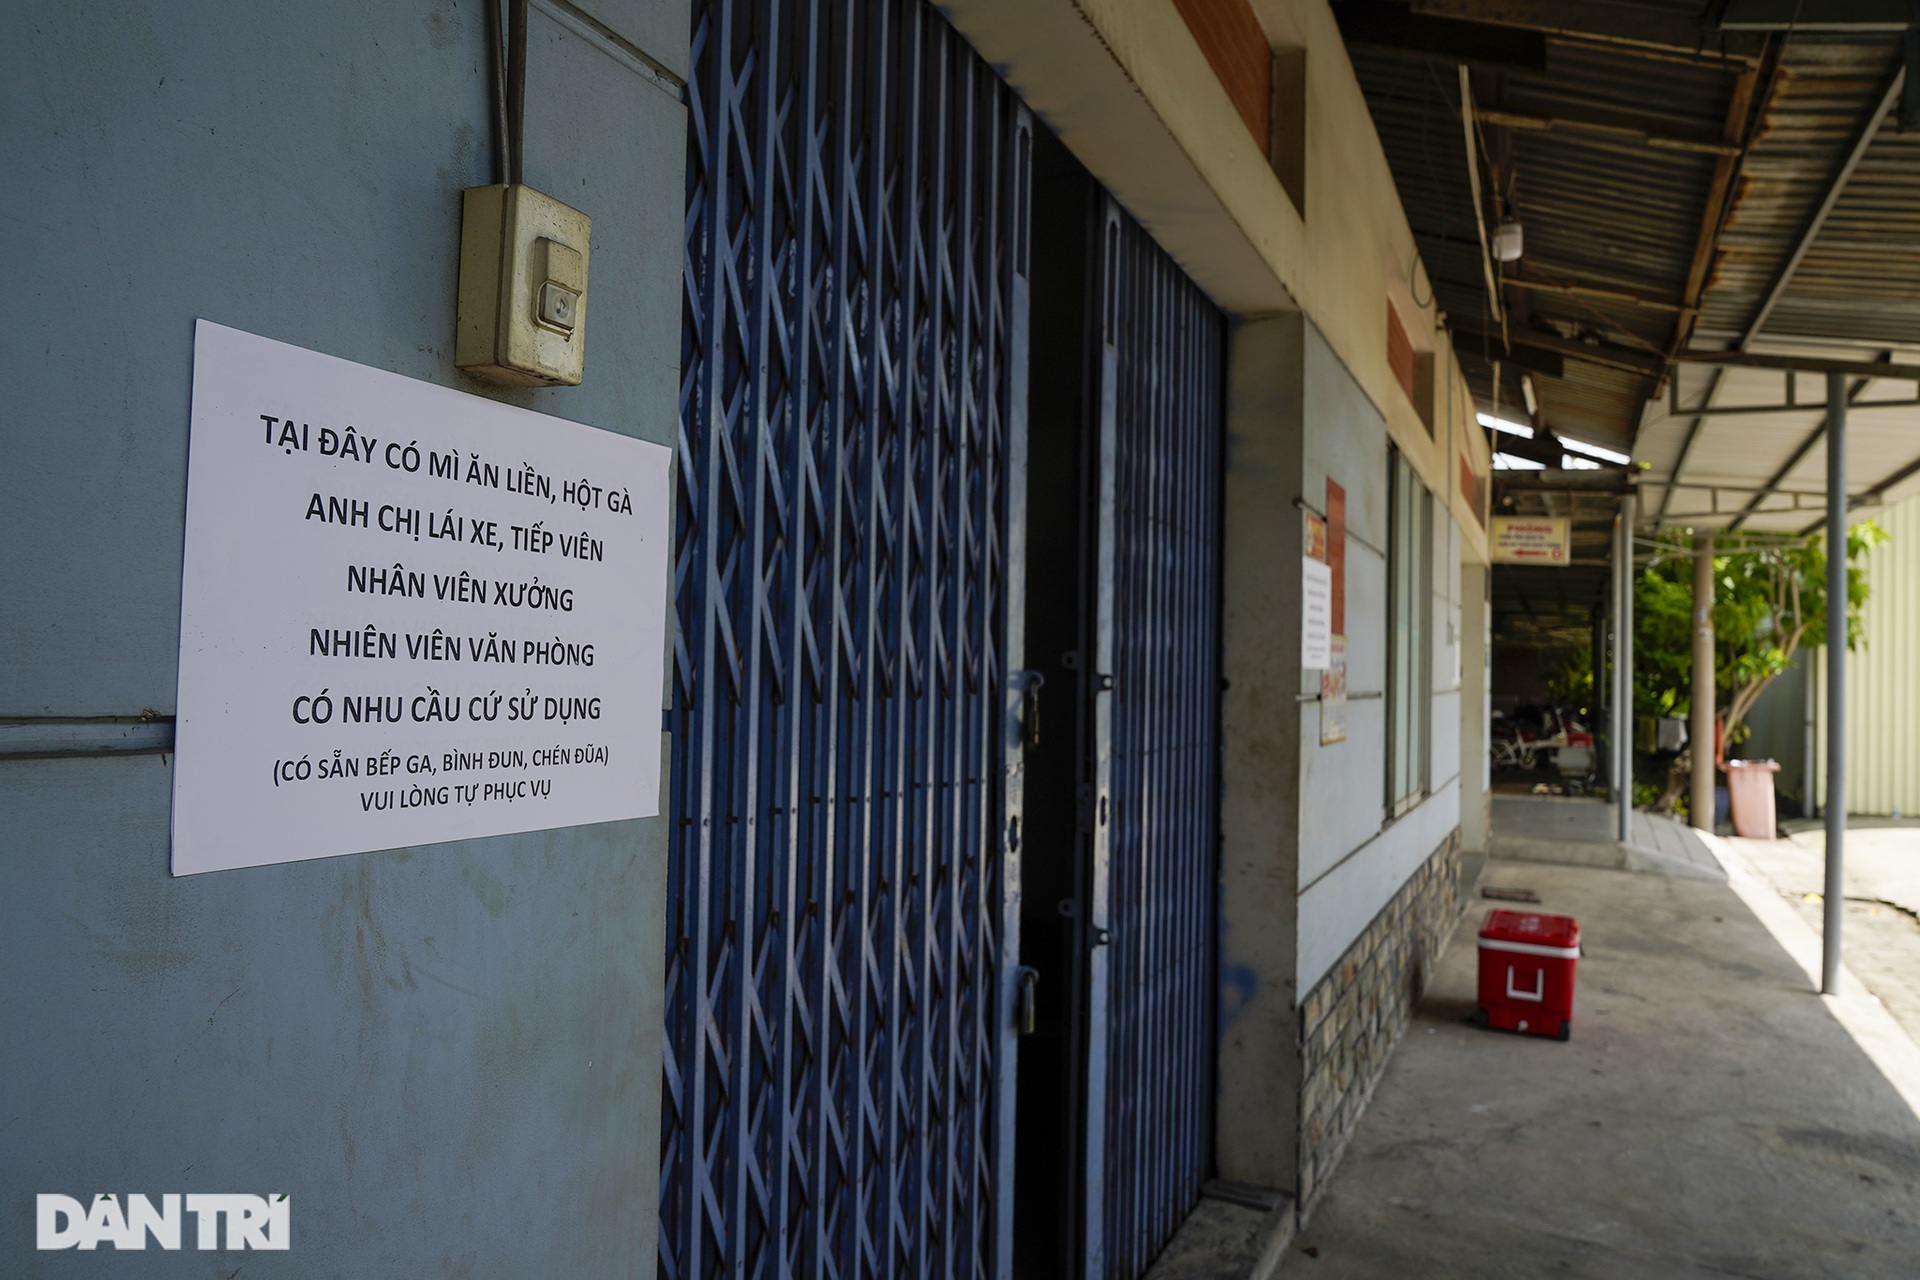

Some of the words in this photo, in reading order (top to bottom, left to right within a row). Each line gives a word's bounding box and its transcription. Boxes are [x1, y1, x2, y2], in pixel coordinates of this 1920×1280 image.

[259, 414, 309, 455] TẠI
[317, 425, 378, 464] ĐÂY
[385, 440, 421, 474] CÓ
[429, 447, 460, 482] MÌ
[465, 456, 499, 490] ĂN
[506, 460, 557, 505] LIỀN,
[562, 476, 604, 511] HỘT
[607, 483, 633, 516] GÀ
[305, 493, 369, 529] ANH
[377, 504, 420, 542] CHỊ
[428, 508, 463, 543] LÁI
[469, 518, 504, 553] XE,
[510, 520, 554, 555] TIẾP
[559, 531, 604, 563] VIÊN
[347, 564, 426, 599] NHÂN
[433, 569, 487, 605] VIÊN
[493, 573, 574, 613] XƯỞNG
[310, 623, 397, 660] NHIÊN
[405, 628, 461, 662] VIÊN
[468, 629, 516, 664] VĂN
[523, 635, 595, 668] PHÒNG
[292, 687, 333, 726] CÓ
[342, 694, 403, 725] NHU
[411, 685, 461, 723] CẦU
[468, 690, 503, 723] CỨ
[507, 687, 540, 722] SỬ
[544, 696, 601, 724] DỤNG
[273, 754, 312, 788] (CÓ
[317, 748, 360, 780] SẴN
[365, 748, 401, 777] BẾP
[406, 753, 438, 777] GA,
[442, 748, 484, 772] BÌNH
[488, 750, 528, 771] ĐUN,
[532, 744, 571, 768] CHÉN
[574, 743, 610, 767] ĐŨA)
[360, 789, 394, 812] VUI
[400, 783, 449, 809] LÒNG
[454, 783, 480, 806] TỰ
[483, 780, 527, 803] PHỤC
[530, 779, 552, 800] VỤ
